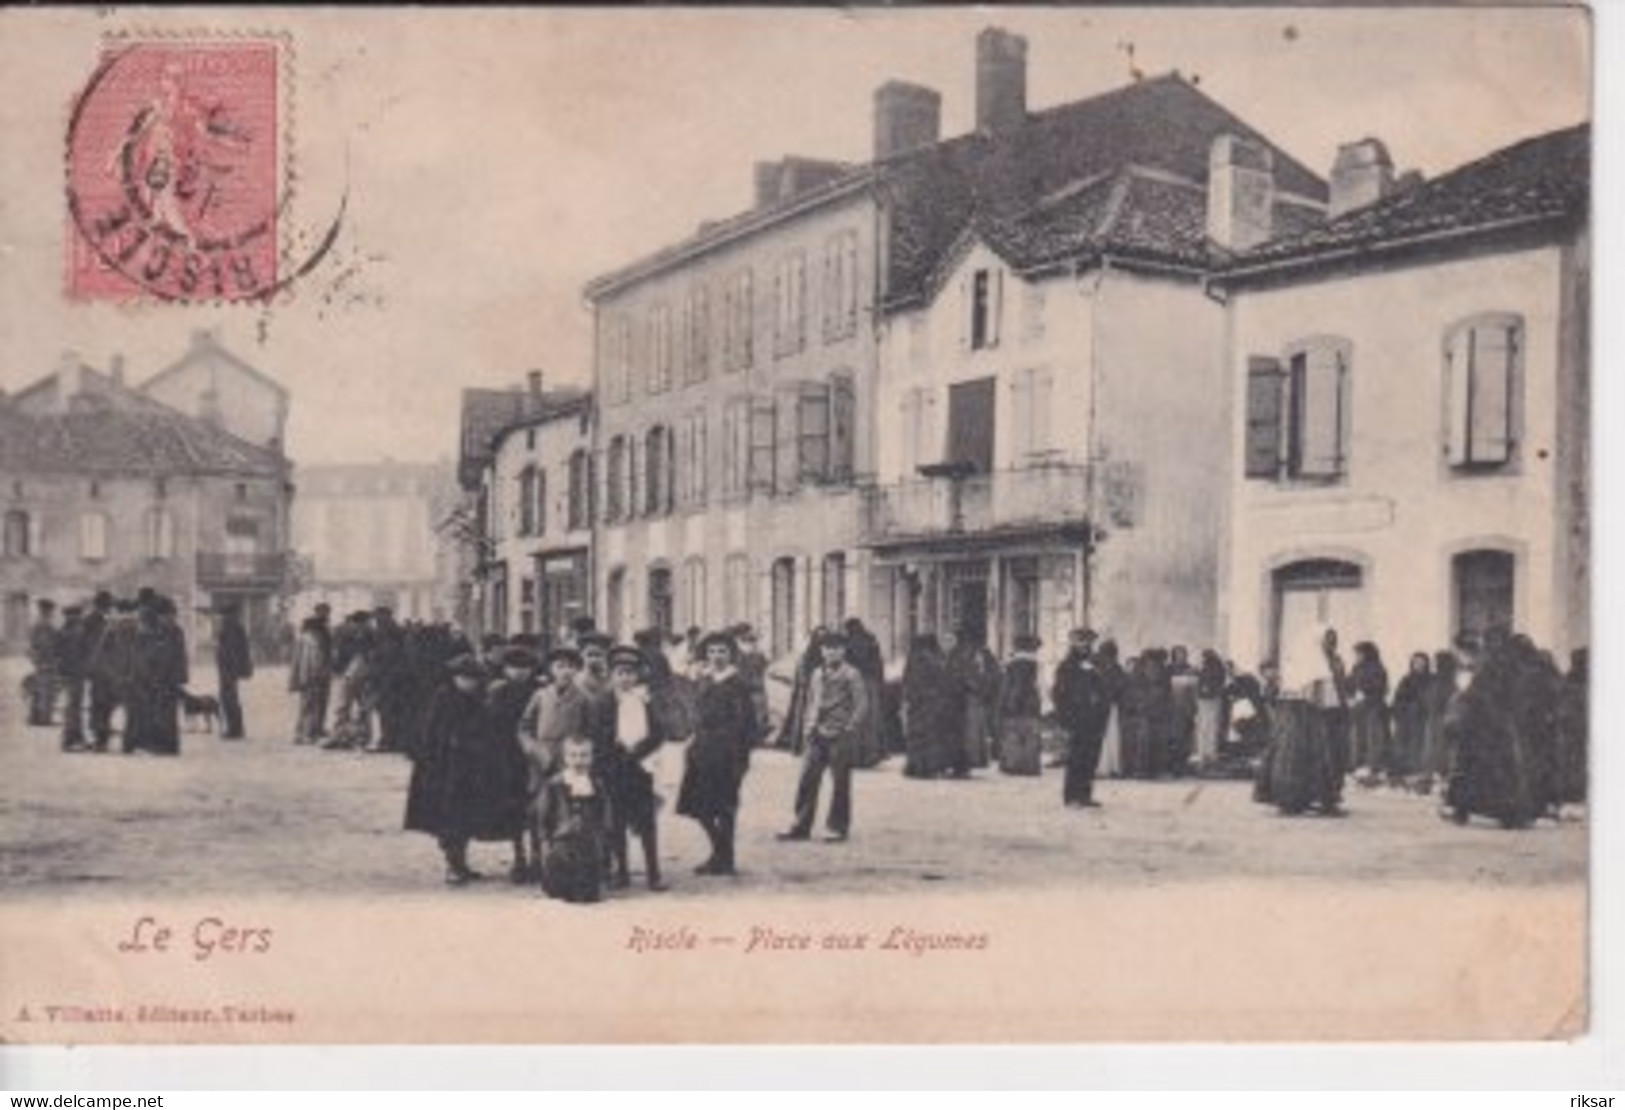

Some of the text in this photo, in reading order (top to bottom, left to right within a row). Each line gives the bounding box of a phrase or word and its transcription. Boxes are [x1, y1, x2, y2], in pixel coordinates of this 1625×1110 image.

[118, 916, 273, 961] Le Gers
[744, 924, 811, 953] Place
[821, 933, 868, 949] aux
